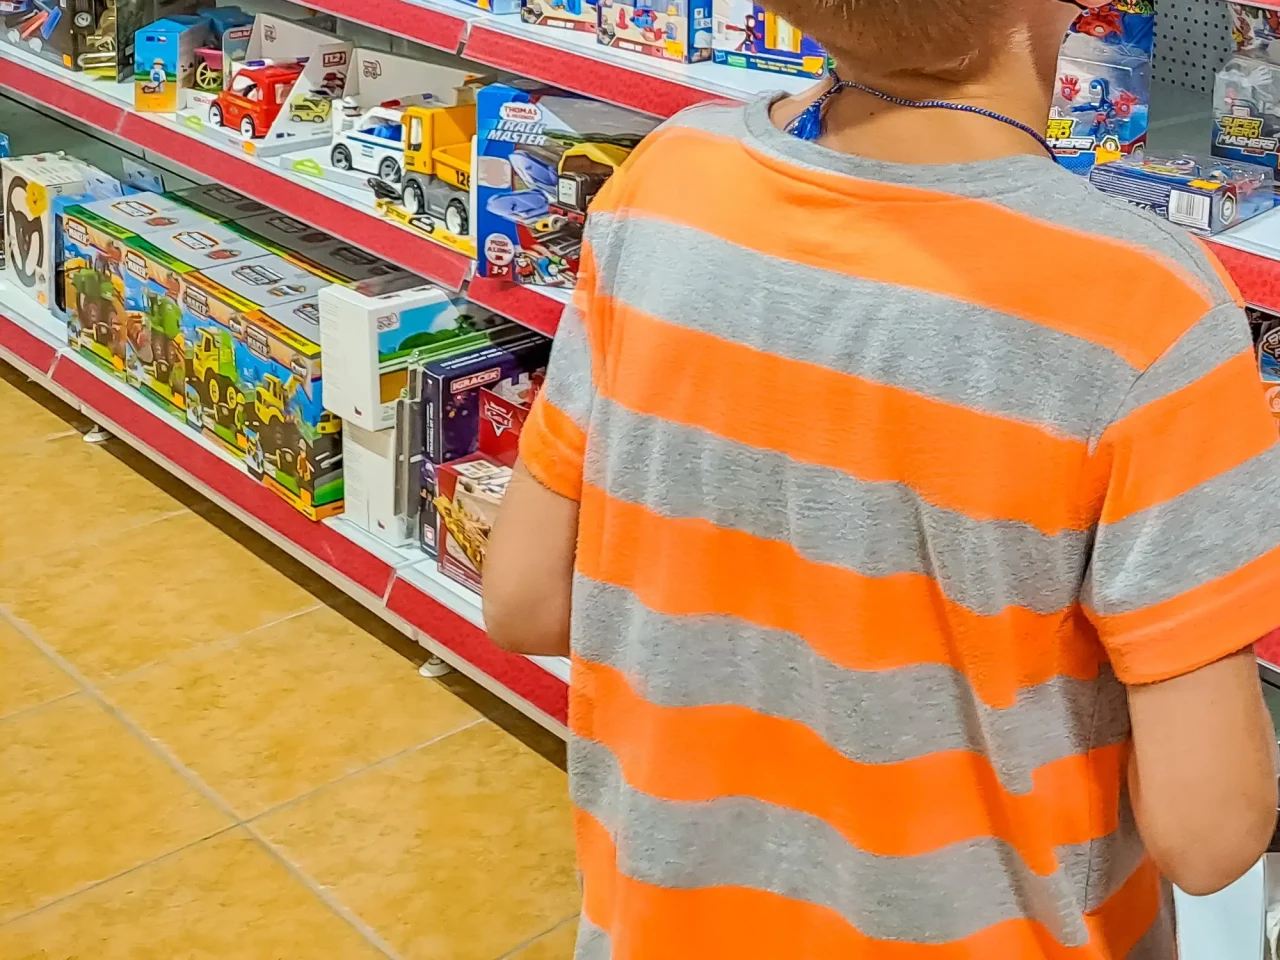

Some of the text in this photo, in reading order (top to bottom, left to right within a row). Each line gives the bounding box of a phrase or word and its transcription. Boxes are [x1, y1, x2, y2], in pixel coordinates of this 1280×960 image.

[504, 105, 538, 116] THOMAS
[498, 119, 548, 134] TRACK
[1221, 117, 1262, 129] SUPER
[487, 129, 547, 146] MASTER
[1224, 127, 1260, 138] HERO
[1219, 133, 1277, 149] MASHERS
